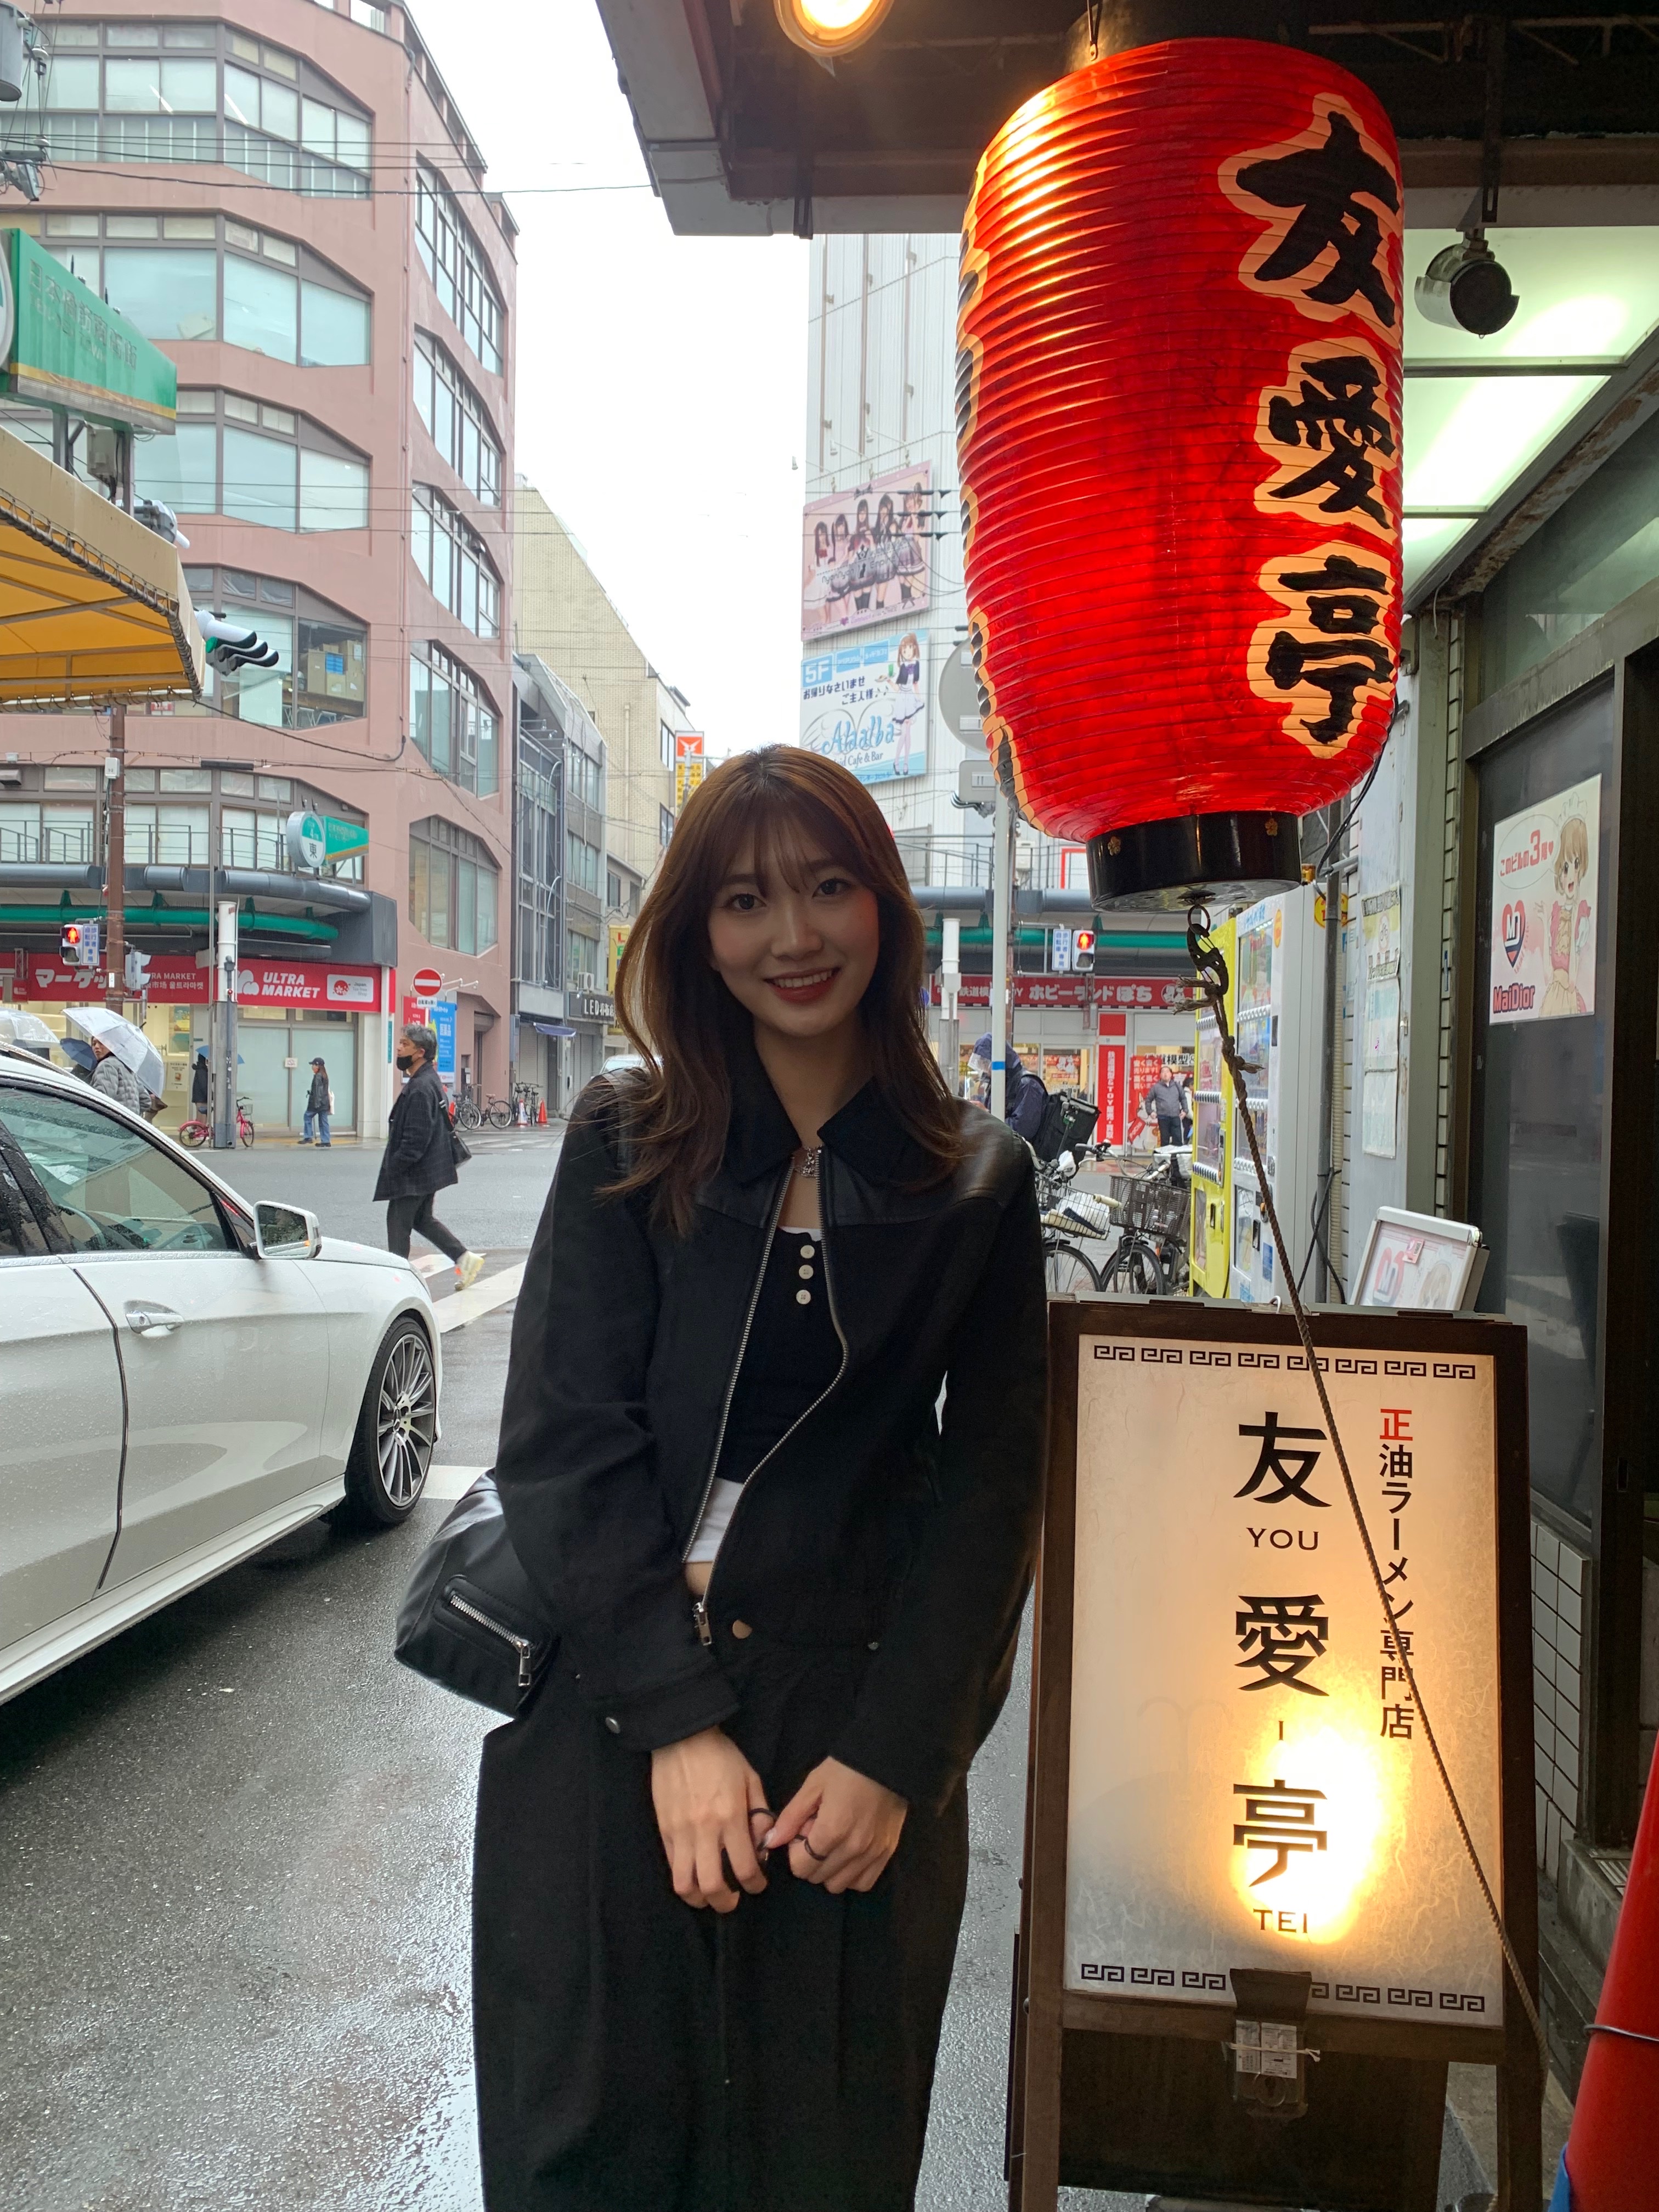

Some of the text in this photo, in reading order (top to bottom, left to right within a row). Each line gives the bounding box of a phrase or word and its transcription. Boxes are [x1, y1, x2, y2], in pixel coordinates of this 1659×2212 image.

[1236, 110, 1401, 743] 友愛亭
[805, 659, 830, 684] 5F
[803, 676, 865, 700] お帰りなさいませ
[848, 753, 863, 768] Cafe
[864, 753, 870, 763] &
[871, 751, 884, 761] Bar
[309, 842, 318, 859] 東
[263, 972, 304, 985] ULTRA
[262, 986, 320, 998] MARKET
[1493, 982, 1536, 1014] MaiDior
[1233, 1412, 1332, 1508] 友
[1245, 1527, 1319, 1550] YOU
[1379, 1408, 1414, 1740] 正油ラーメン専門店
[1234, 1594, 1330, 1697] 愛
[1233, 1779, 1328, 1887] 亭
[1252, 1908, 1309, 1933] TEI
